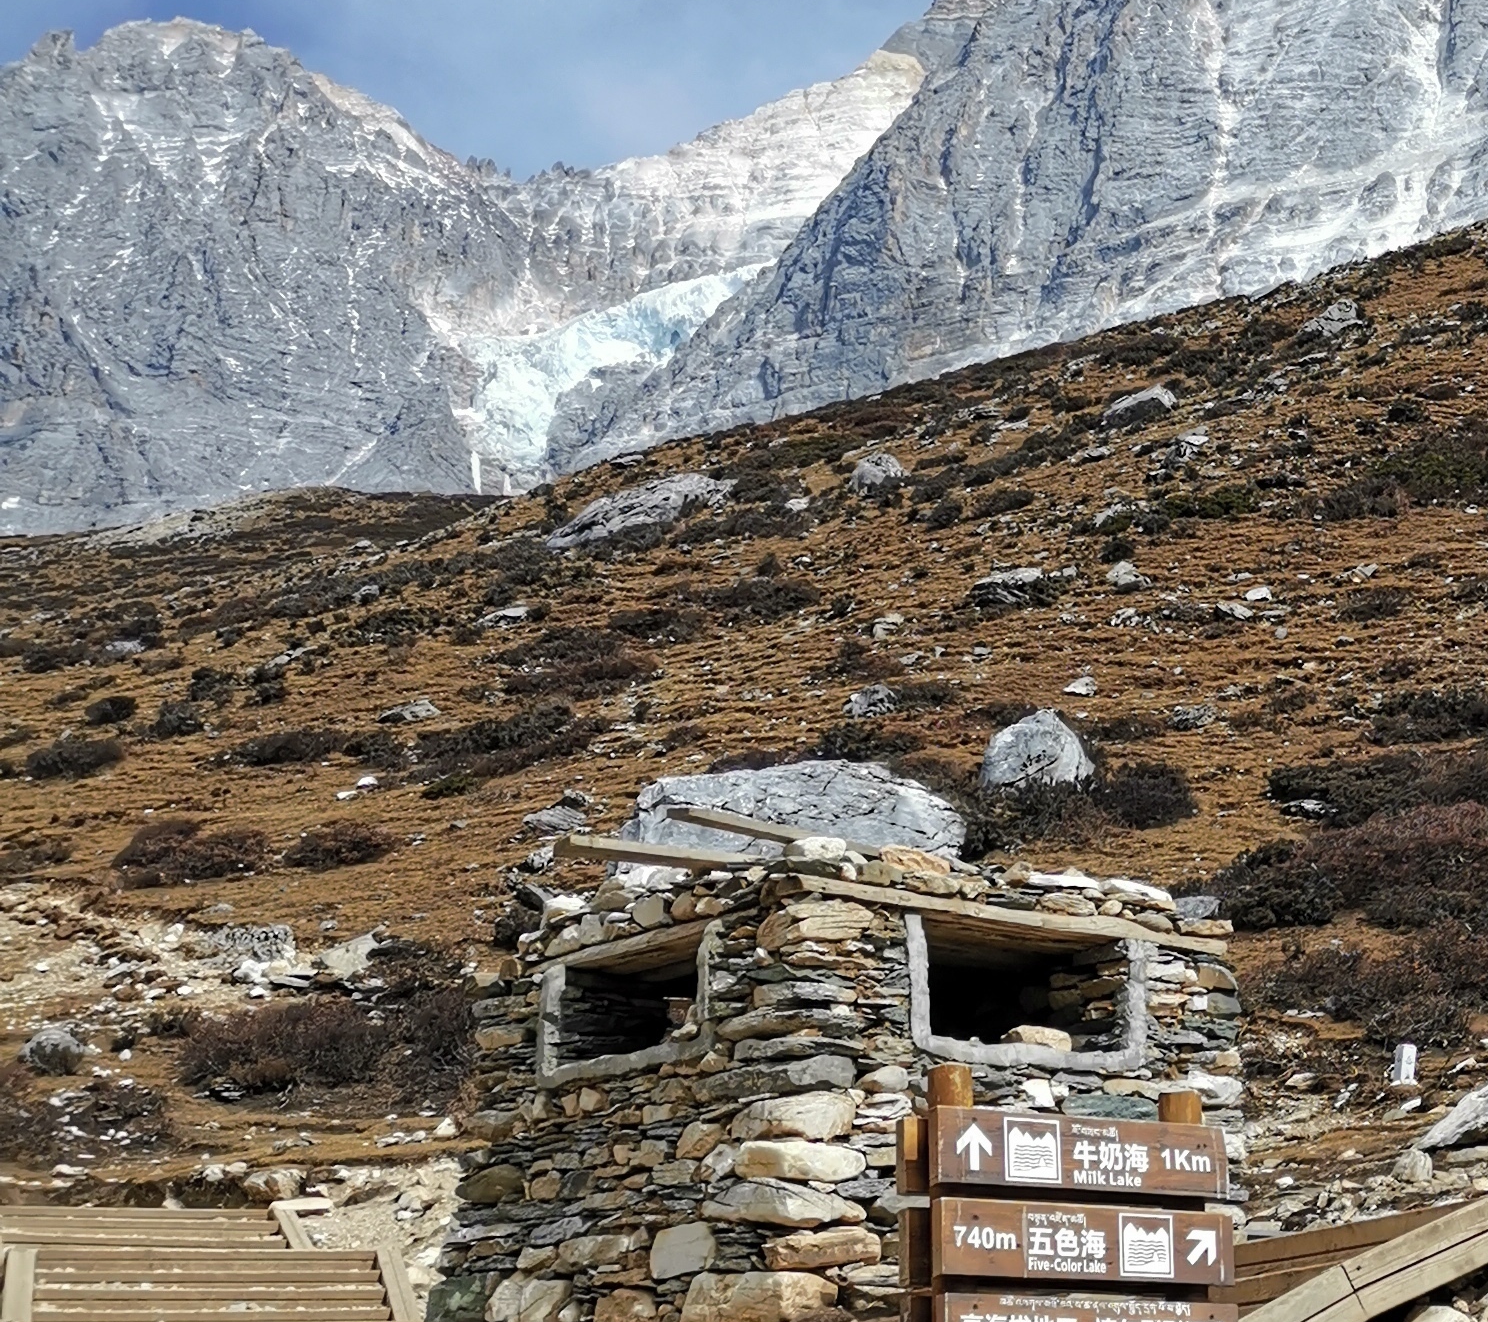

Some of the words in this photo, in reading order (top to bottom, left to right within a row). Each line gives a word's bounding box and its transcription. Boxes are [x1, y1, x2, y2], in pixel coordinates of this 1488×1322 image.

[1073, 1140, 1149, 1173] 牛奶海
[1161, 1148, 1211, 1173] 1Km
[1073, 1170, 1107, 1185] Milk
[1110, 1172, 1142, 1187] Lake
[952, 1225, 1017, 1250] 740m
[1028, 1228, 1106, 1259] 五色海
[1028, 1257, 1082, 1273] Five-Color
[1083, 1259, 1107, 1274] Lake
